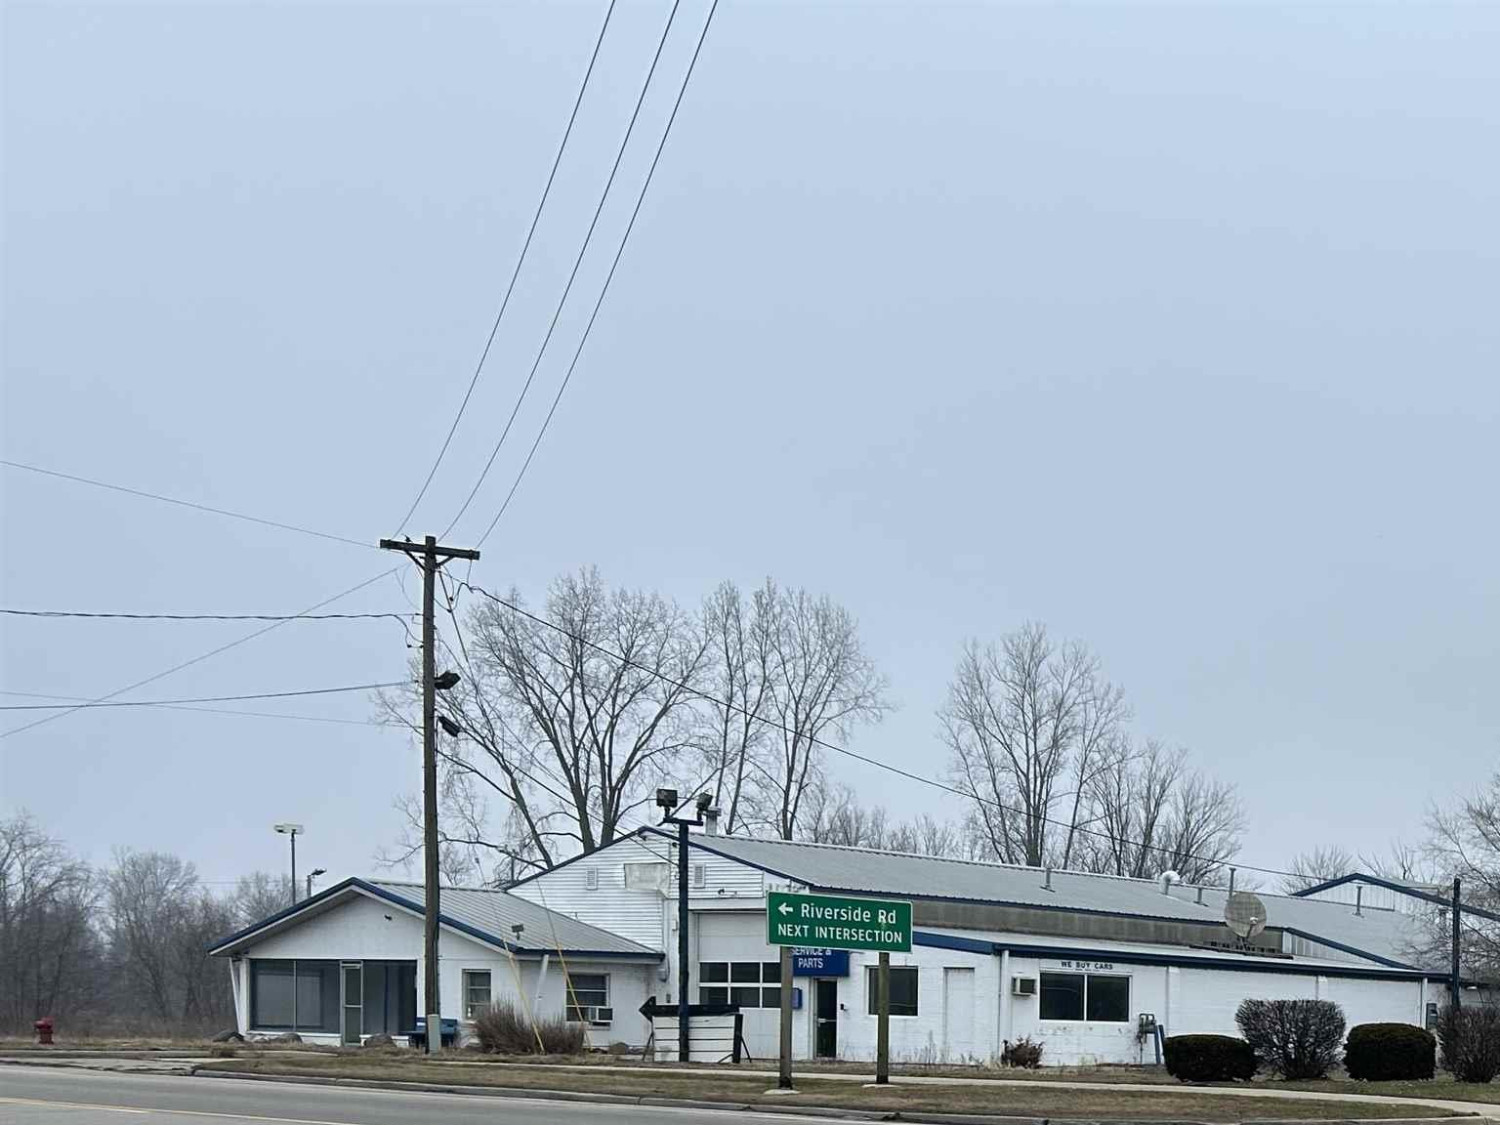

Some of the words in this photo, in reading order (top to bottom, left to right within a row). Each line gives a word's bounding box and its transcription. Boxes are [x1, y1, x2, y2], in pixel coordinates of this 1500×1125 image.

[801, 903, 871, 922] Riverside
[878, 910, 897, 924] Rd
[777, 923, 809, 938] NEXT
[815, 926, 903, 944] INTERSECTION
[798, 957, 824, 969] PARTS
[1061, 960, 1072, 968] WE
[1094, 962, 1113, 970] CARS
